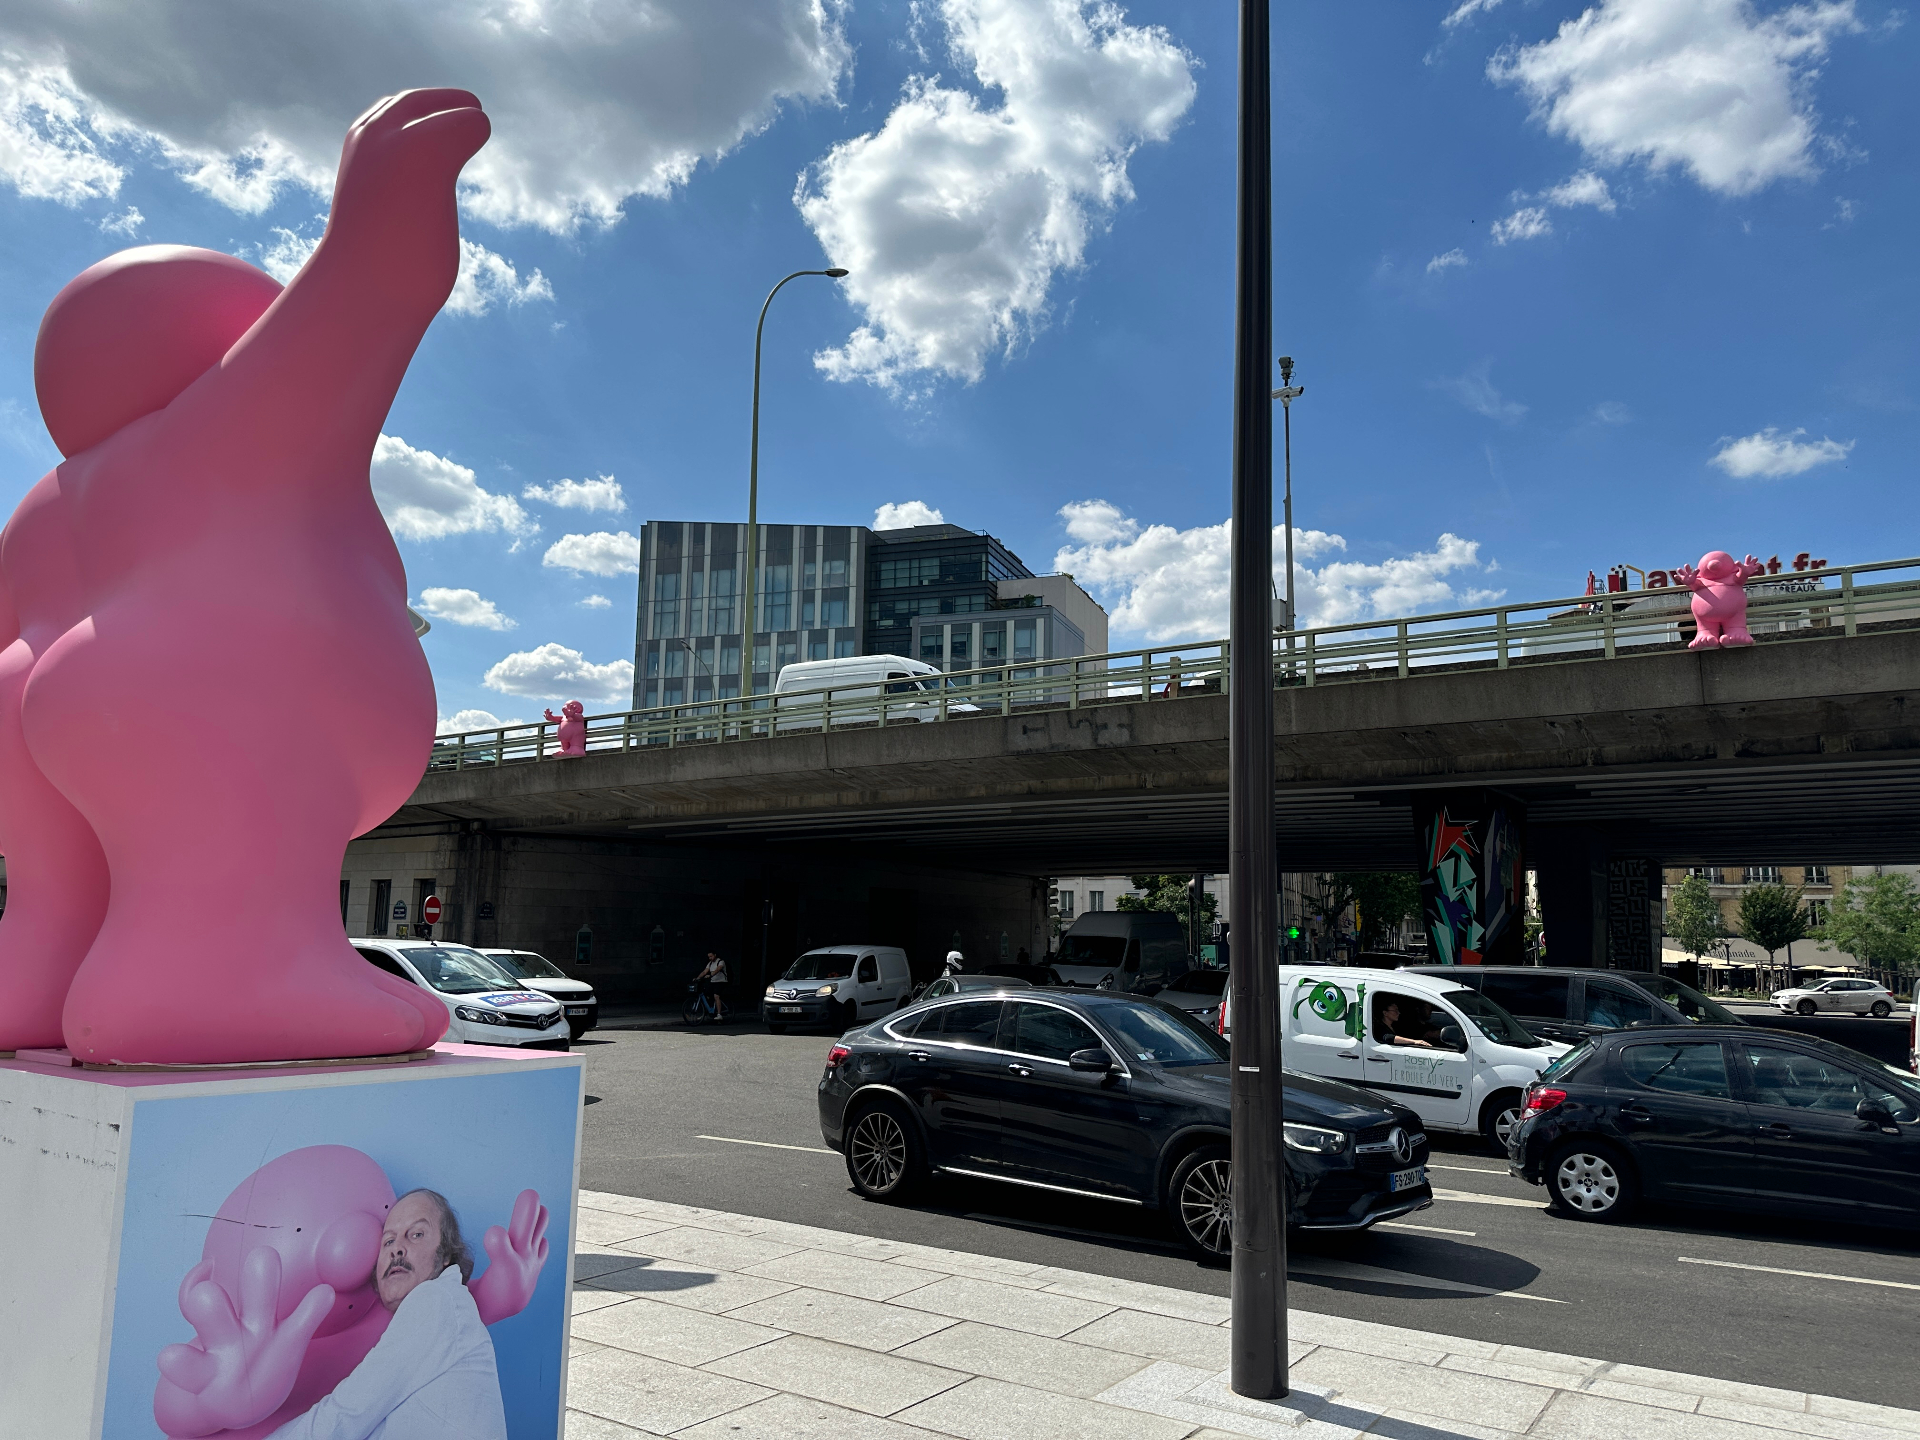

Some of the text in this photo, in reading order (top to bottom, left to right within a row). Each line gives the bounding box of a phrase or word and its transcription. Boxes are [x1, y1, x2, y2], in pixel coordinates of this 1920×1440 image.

[1400, 1069, 1424, 1085] ROULE
[1426, 1073, 1437, 1086] AU
[1439, 1076, 1459, 1088] VERT
